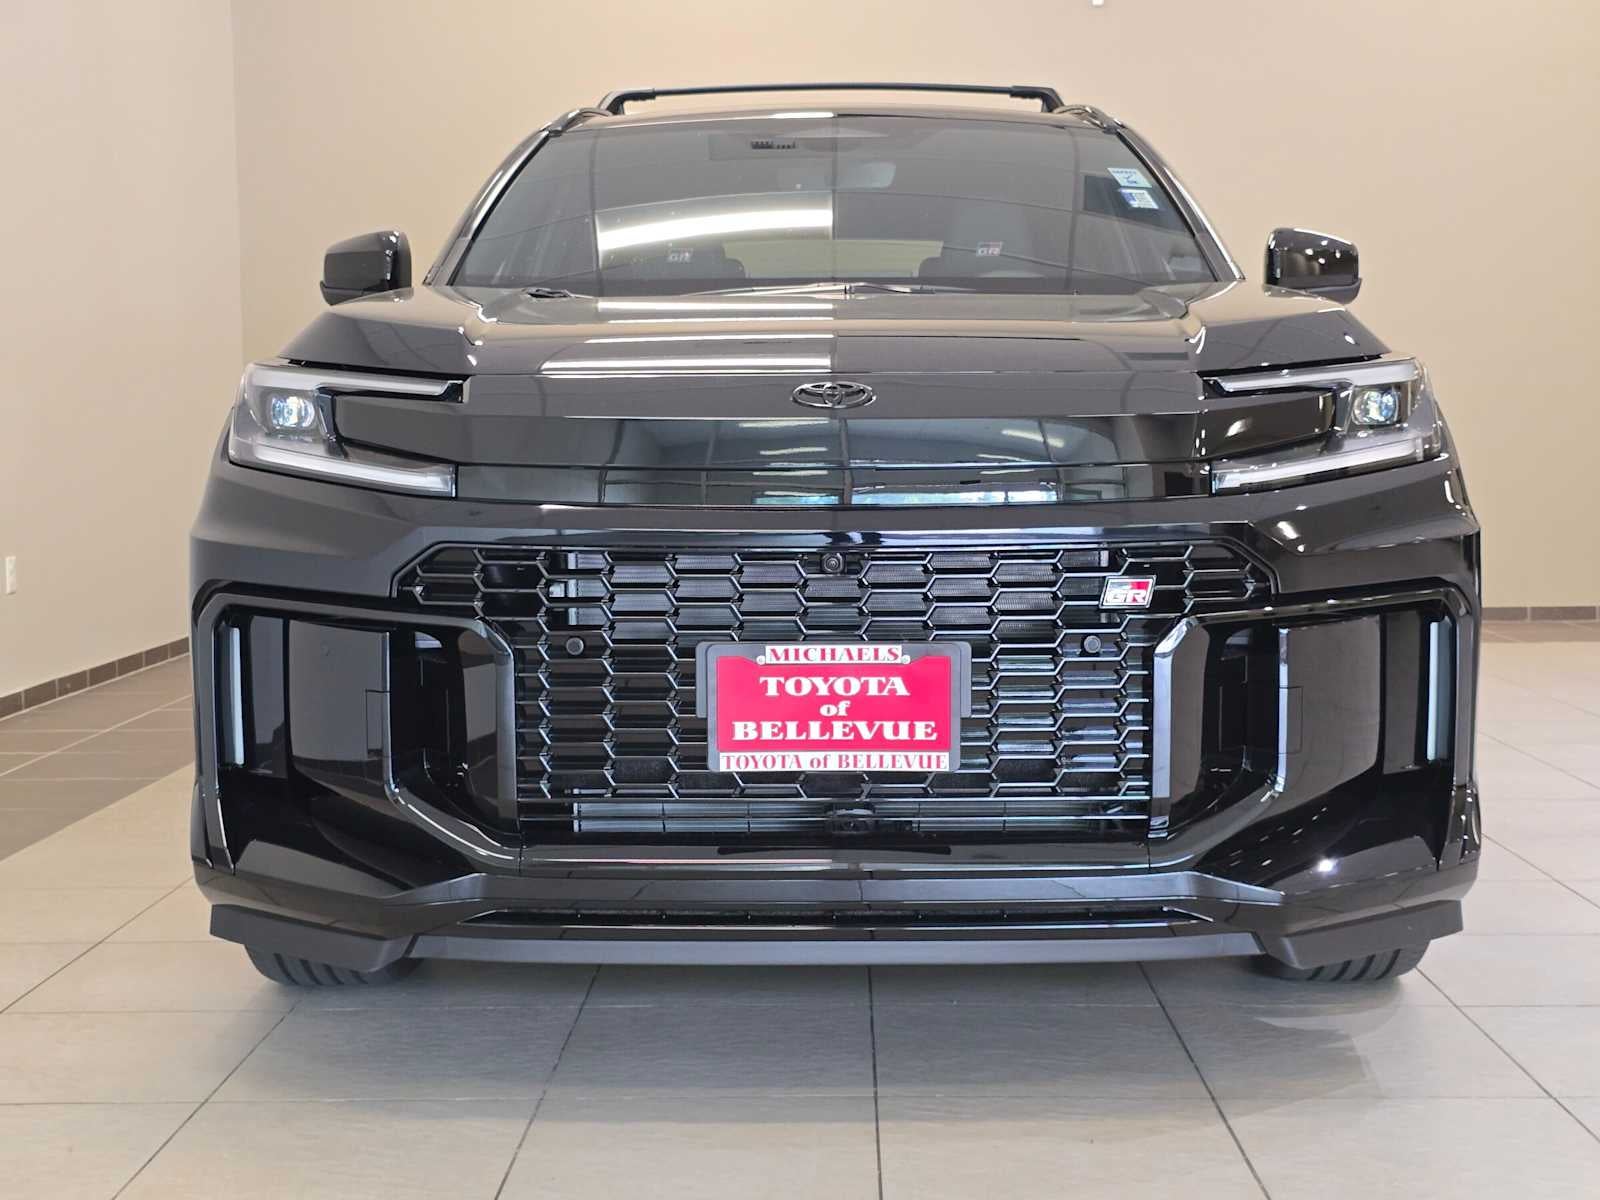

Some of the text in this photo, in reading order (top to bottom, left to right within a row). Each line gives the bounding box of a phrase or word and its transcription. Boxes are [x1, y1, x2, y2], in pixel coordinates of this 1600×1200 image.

[1105, 590, 1148, 604] GR
[769, 647, 900, 662] MICHAELS
[759, 676, 910, 697] TOYOTA
[819, 700, 851, 717] of
[732, 721, 938, 741] BELLEVUE
[721, 753, 948, 770] TOYOTA of BELLEVUE
